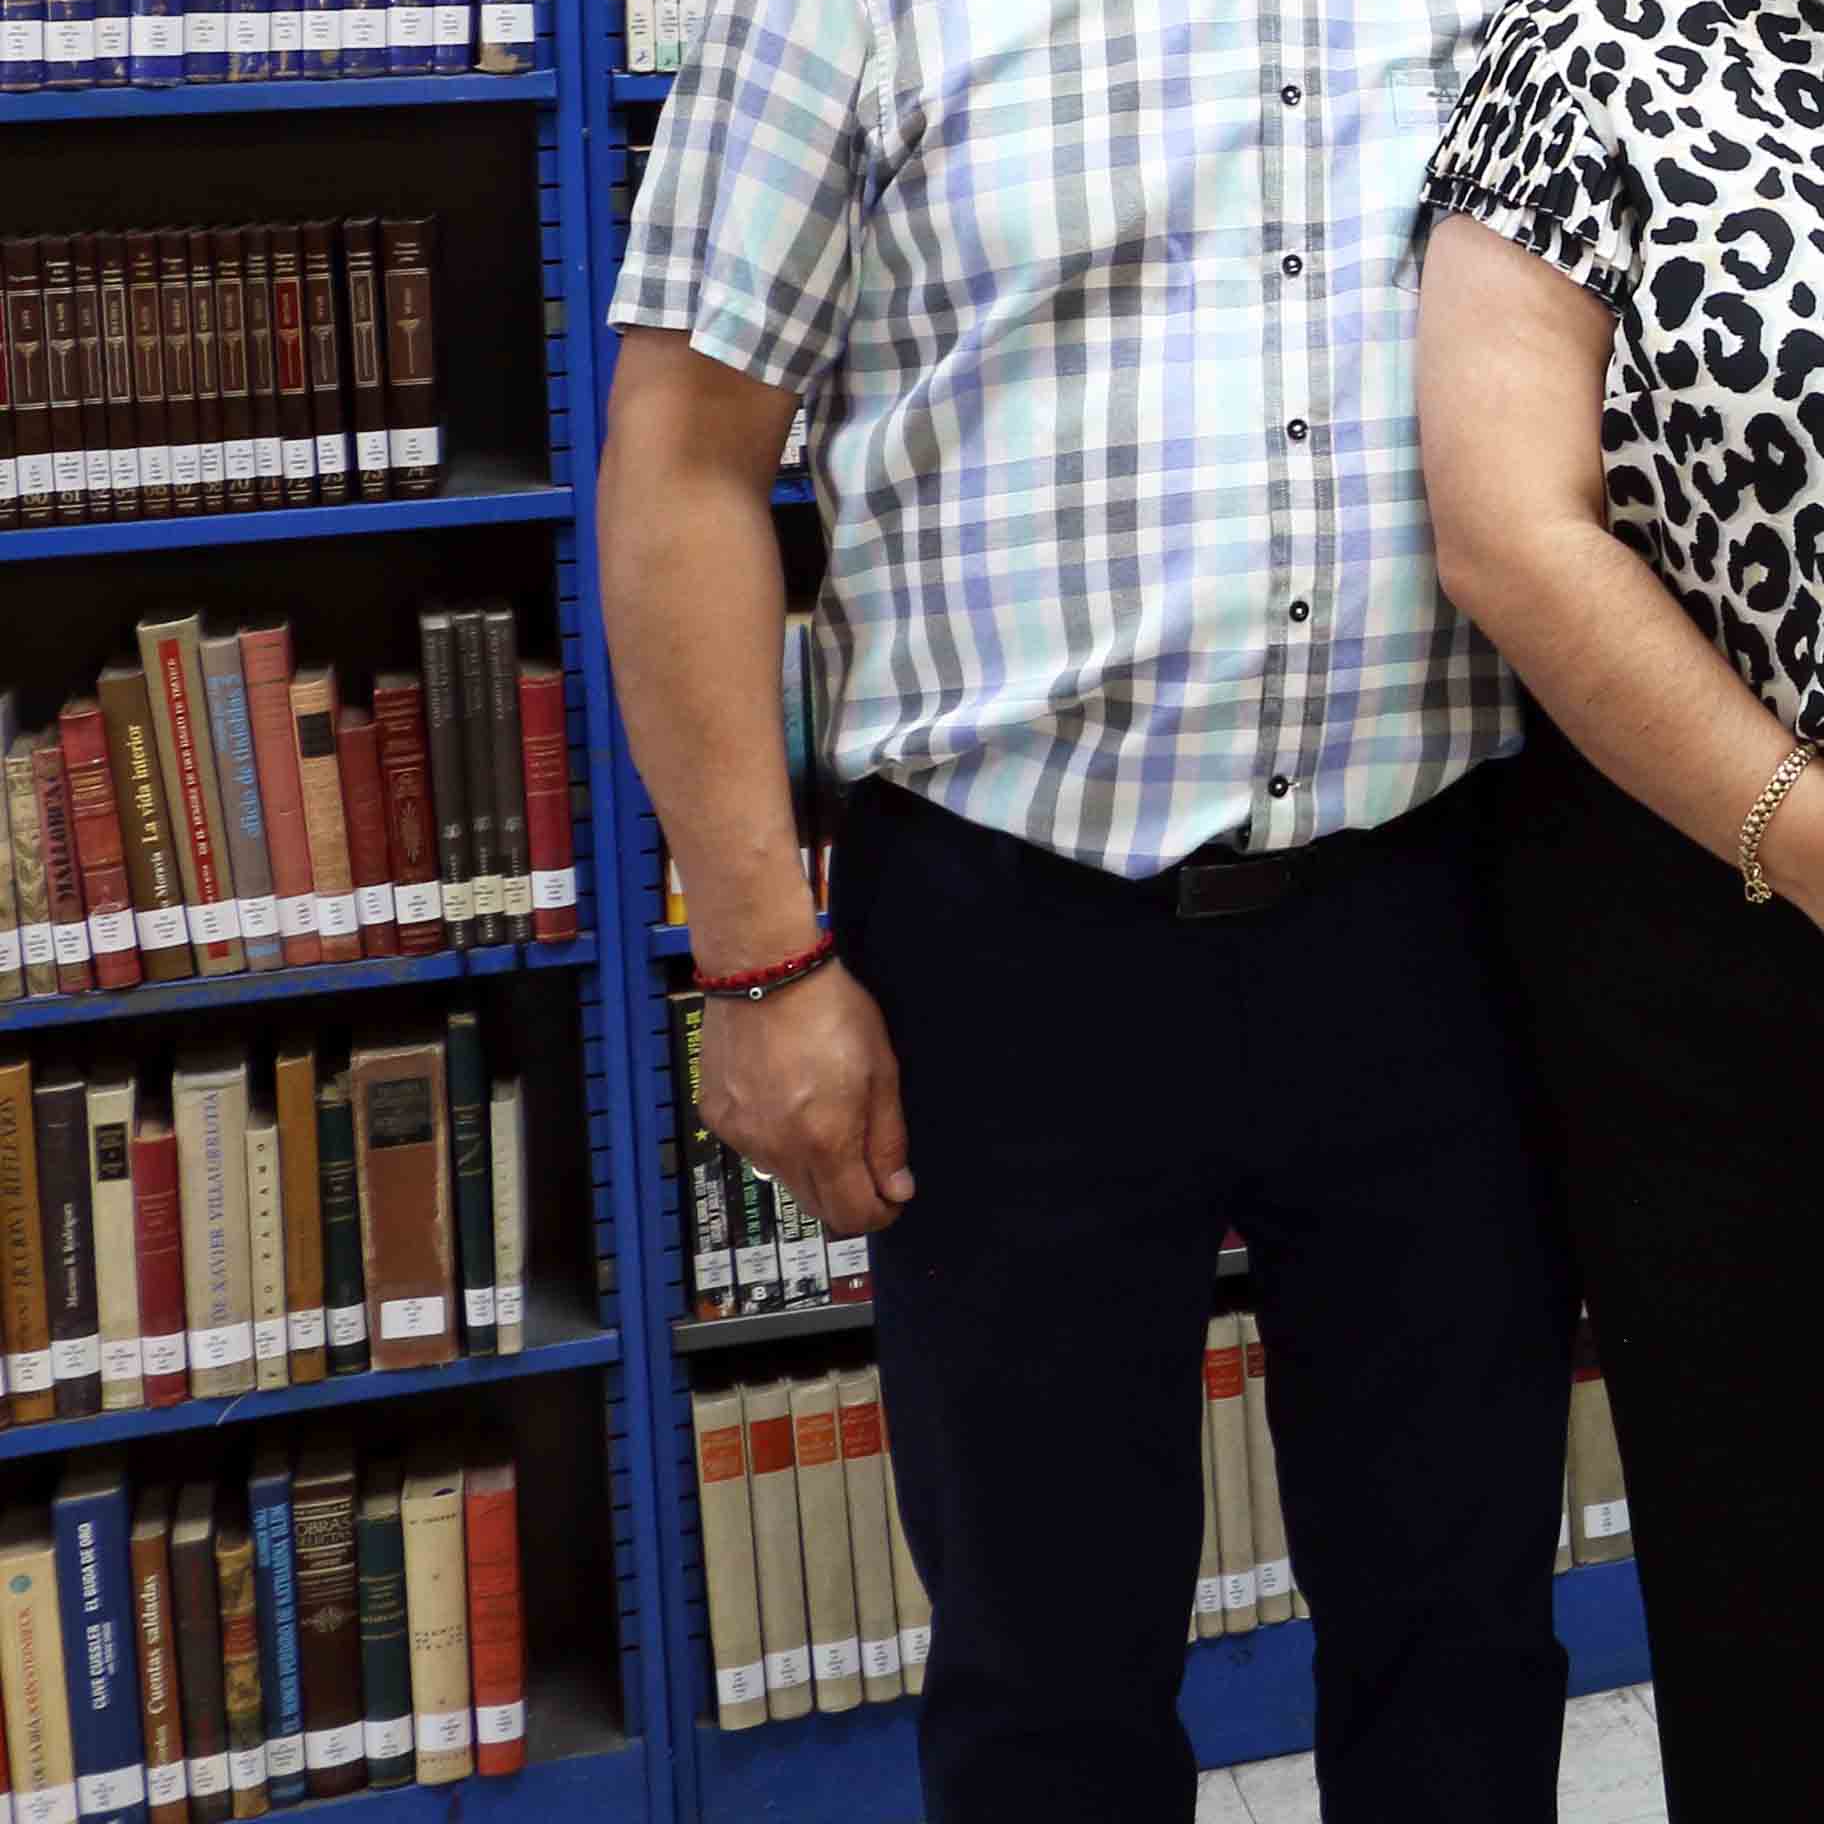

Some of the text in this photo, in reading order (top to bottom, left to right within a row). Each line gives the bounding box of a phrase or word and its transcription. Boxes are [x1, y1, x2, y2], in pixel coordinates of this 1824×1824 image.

[125, 723, 169, 897] Moravia La vida interior
[77, 1520, 100, 1613] EL BUDA DE ORO
[85, 1623, 109, 1711] CLIVE CUSSLER
[139, 1575, 168, 1715] Cuentas saldadas
